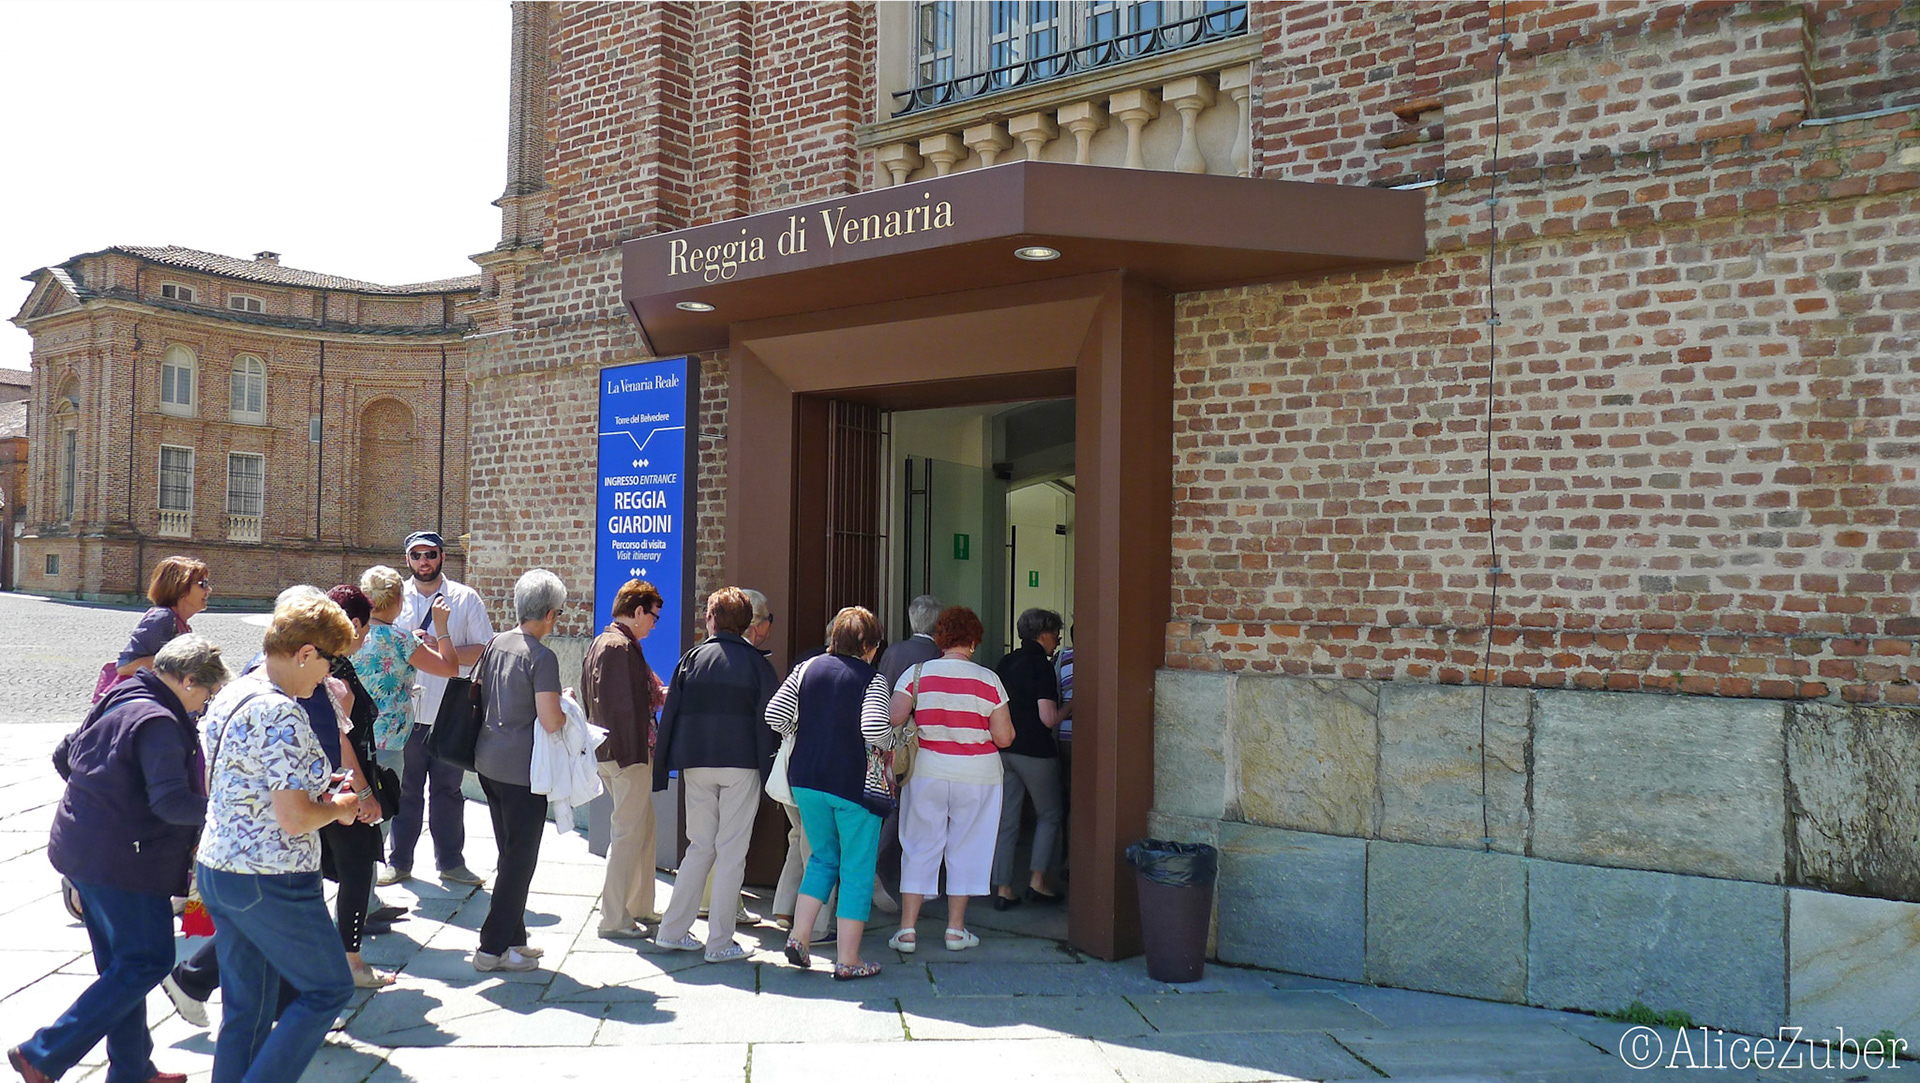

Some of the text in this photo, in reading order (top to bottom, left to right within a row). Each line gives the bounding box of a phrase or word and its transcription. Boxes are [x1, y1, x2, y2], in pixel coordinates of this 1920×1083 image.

[667, 192, 955, 283] Reggia di Venaria
[608, 373, 679, 394] La Venaria Reale
[614, 412, 670, 425] Torre del Belvedere
[604, 473, 677, 487] INGRESSO ENTRANCE
[614, 490, 666, 510] REGGIA
[608, 515, 672, 534] GIARDINI
[611, 539, 666, 549] Percorso di visita
[616, 551, 661, 562] Visit itinerary
